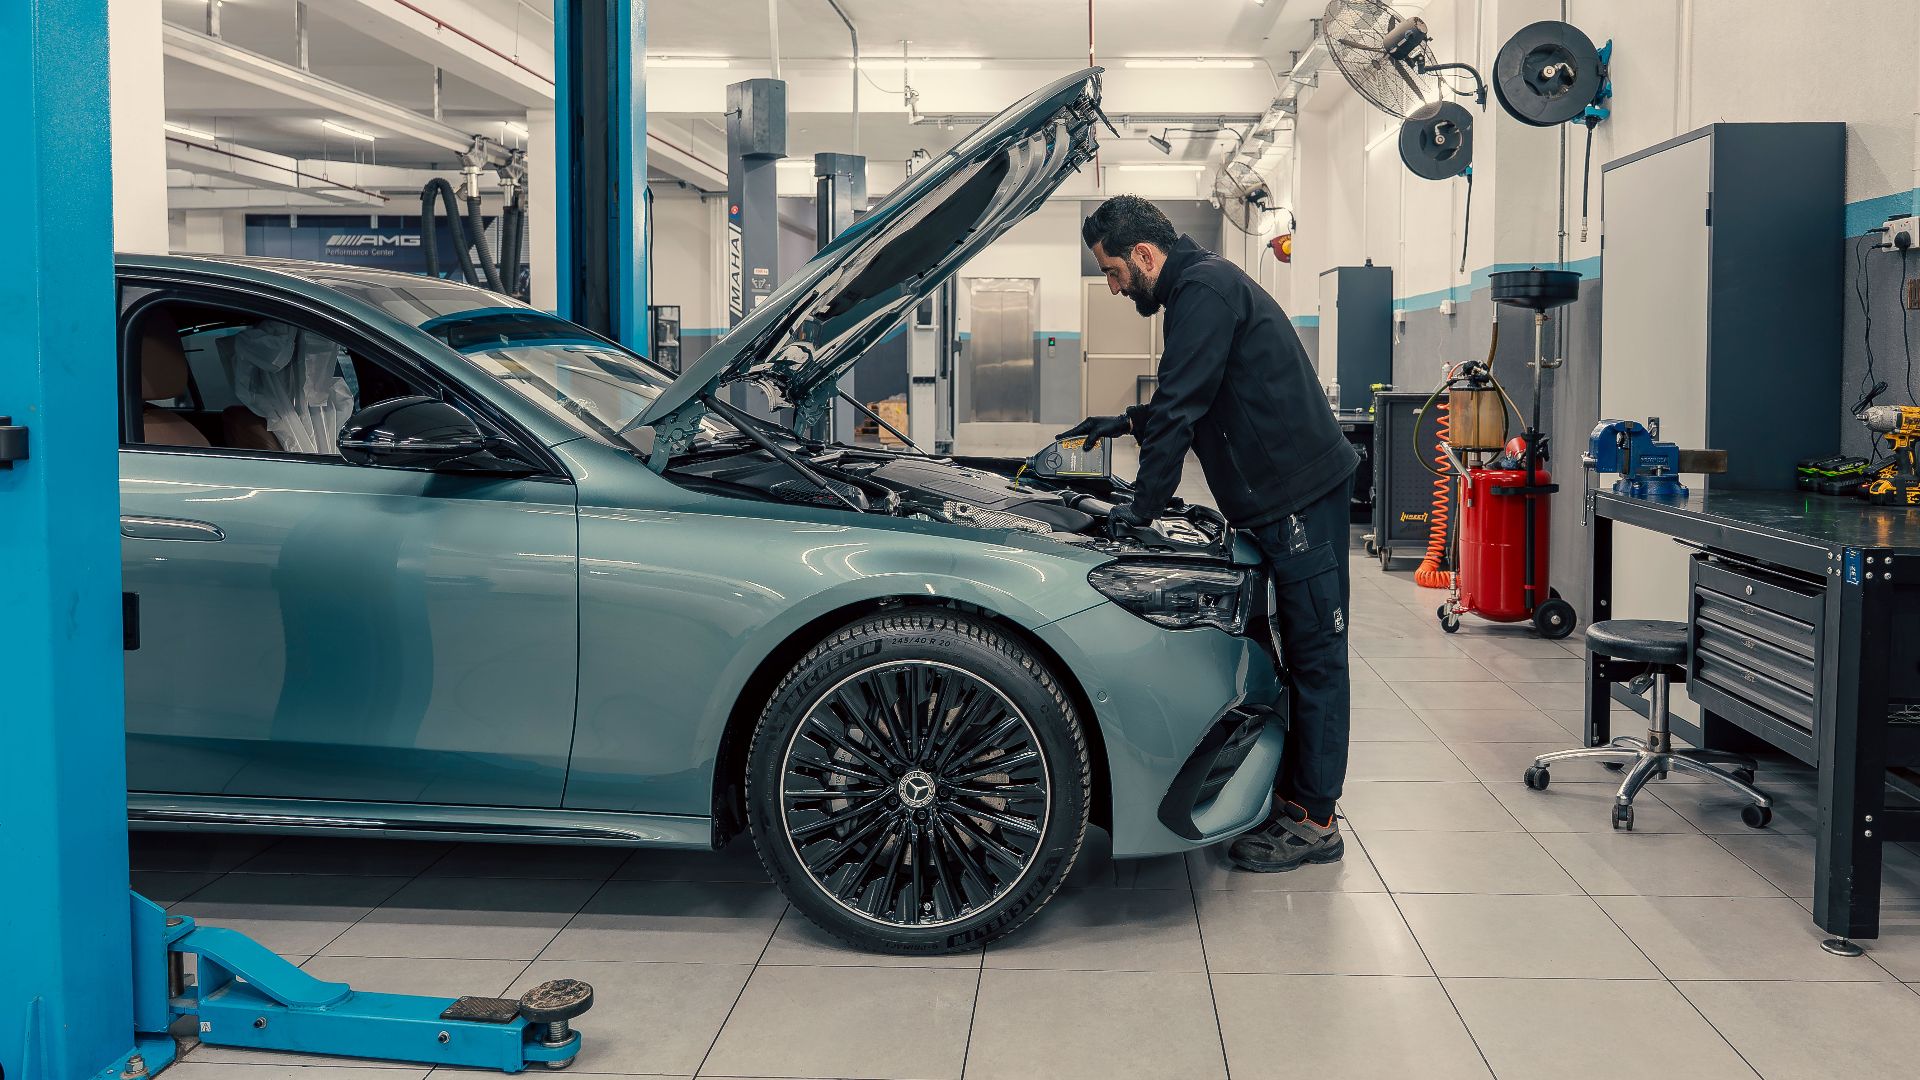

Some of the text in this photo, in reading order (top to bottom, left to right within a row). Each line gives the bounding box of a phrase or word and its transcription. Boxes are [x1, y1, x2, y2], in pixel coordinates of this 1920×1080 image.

[356, 234, 420, 246] AMG
[325, 247, 395, 256] Performance Center
[731, 237, 741, 306] MAHA
[891, 637, 951, 647] 245/40 R 20
[785, 640, 877, 707] MICHELIN
